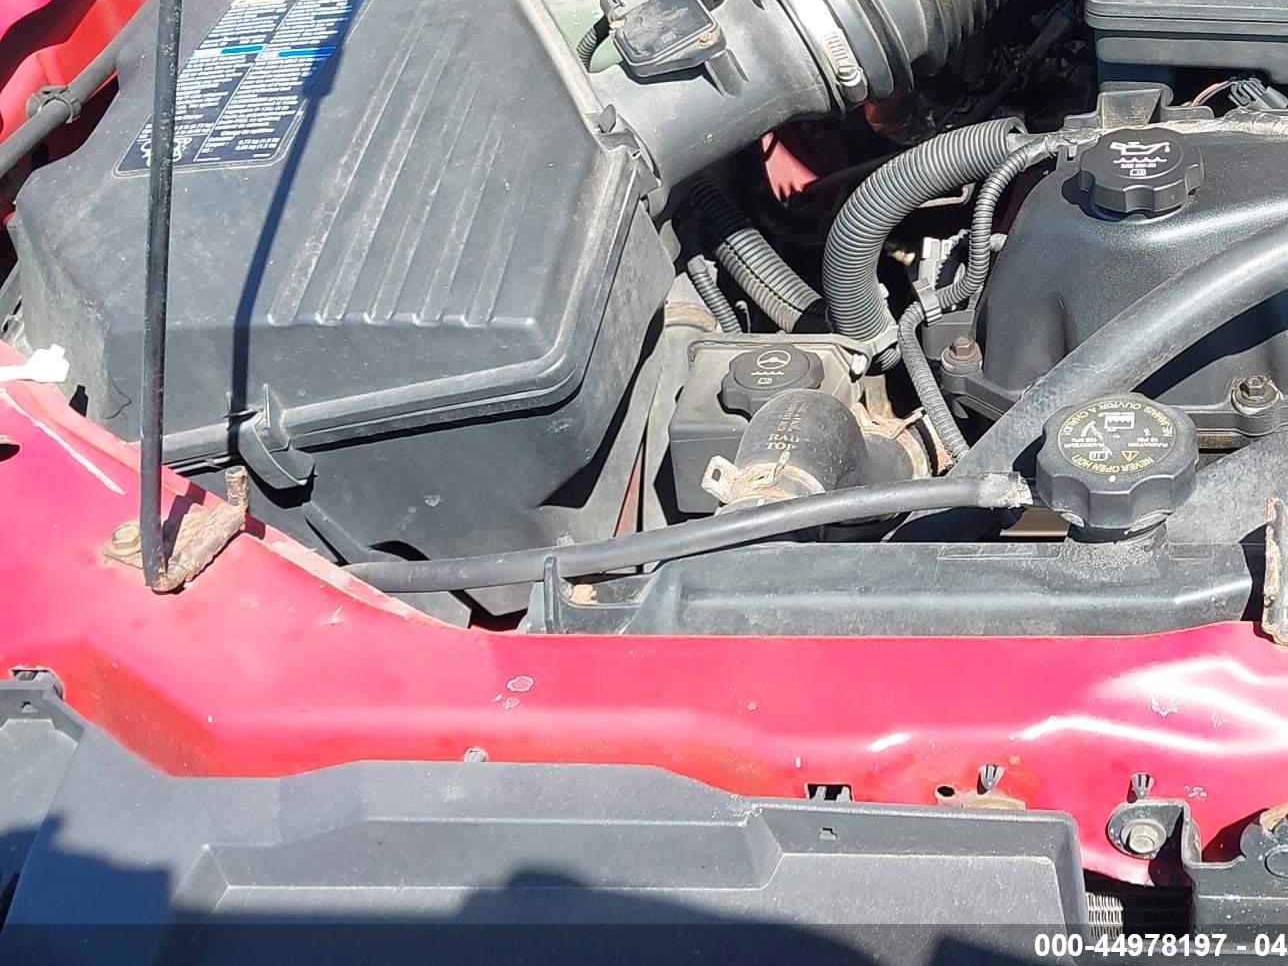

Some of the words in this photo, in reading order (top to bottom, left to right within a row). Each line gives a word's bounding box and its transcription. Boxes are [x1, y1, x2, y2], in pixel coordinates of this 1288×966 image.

[1099, 401, 1141, 410] OUVRIR
[768, 433, 800, 443] RAD
[767, 442, 798, 450] TOP
[1092, 462, 1120, 473] OPEN
[1120, 456, 1155, 472] NEVER
